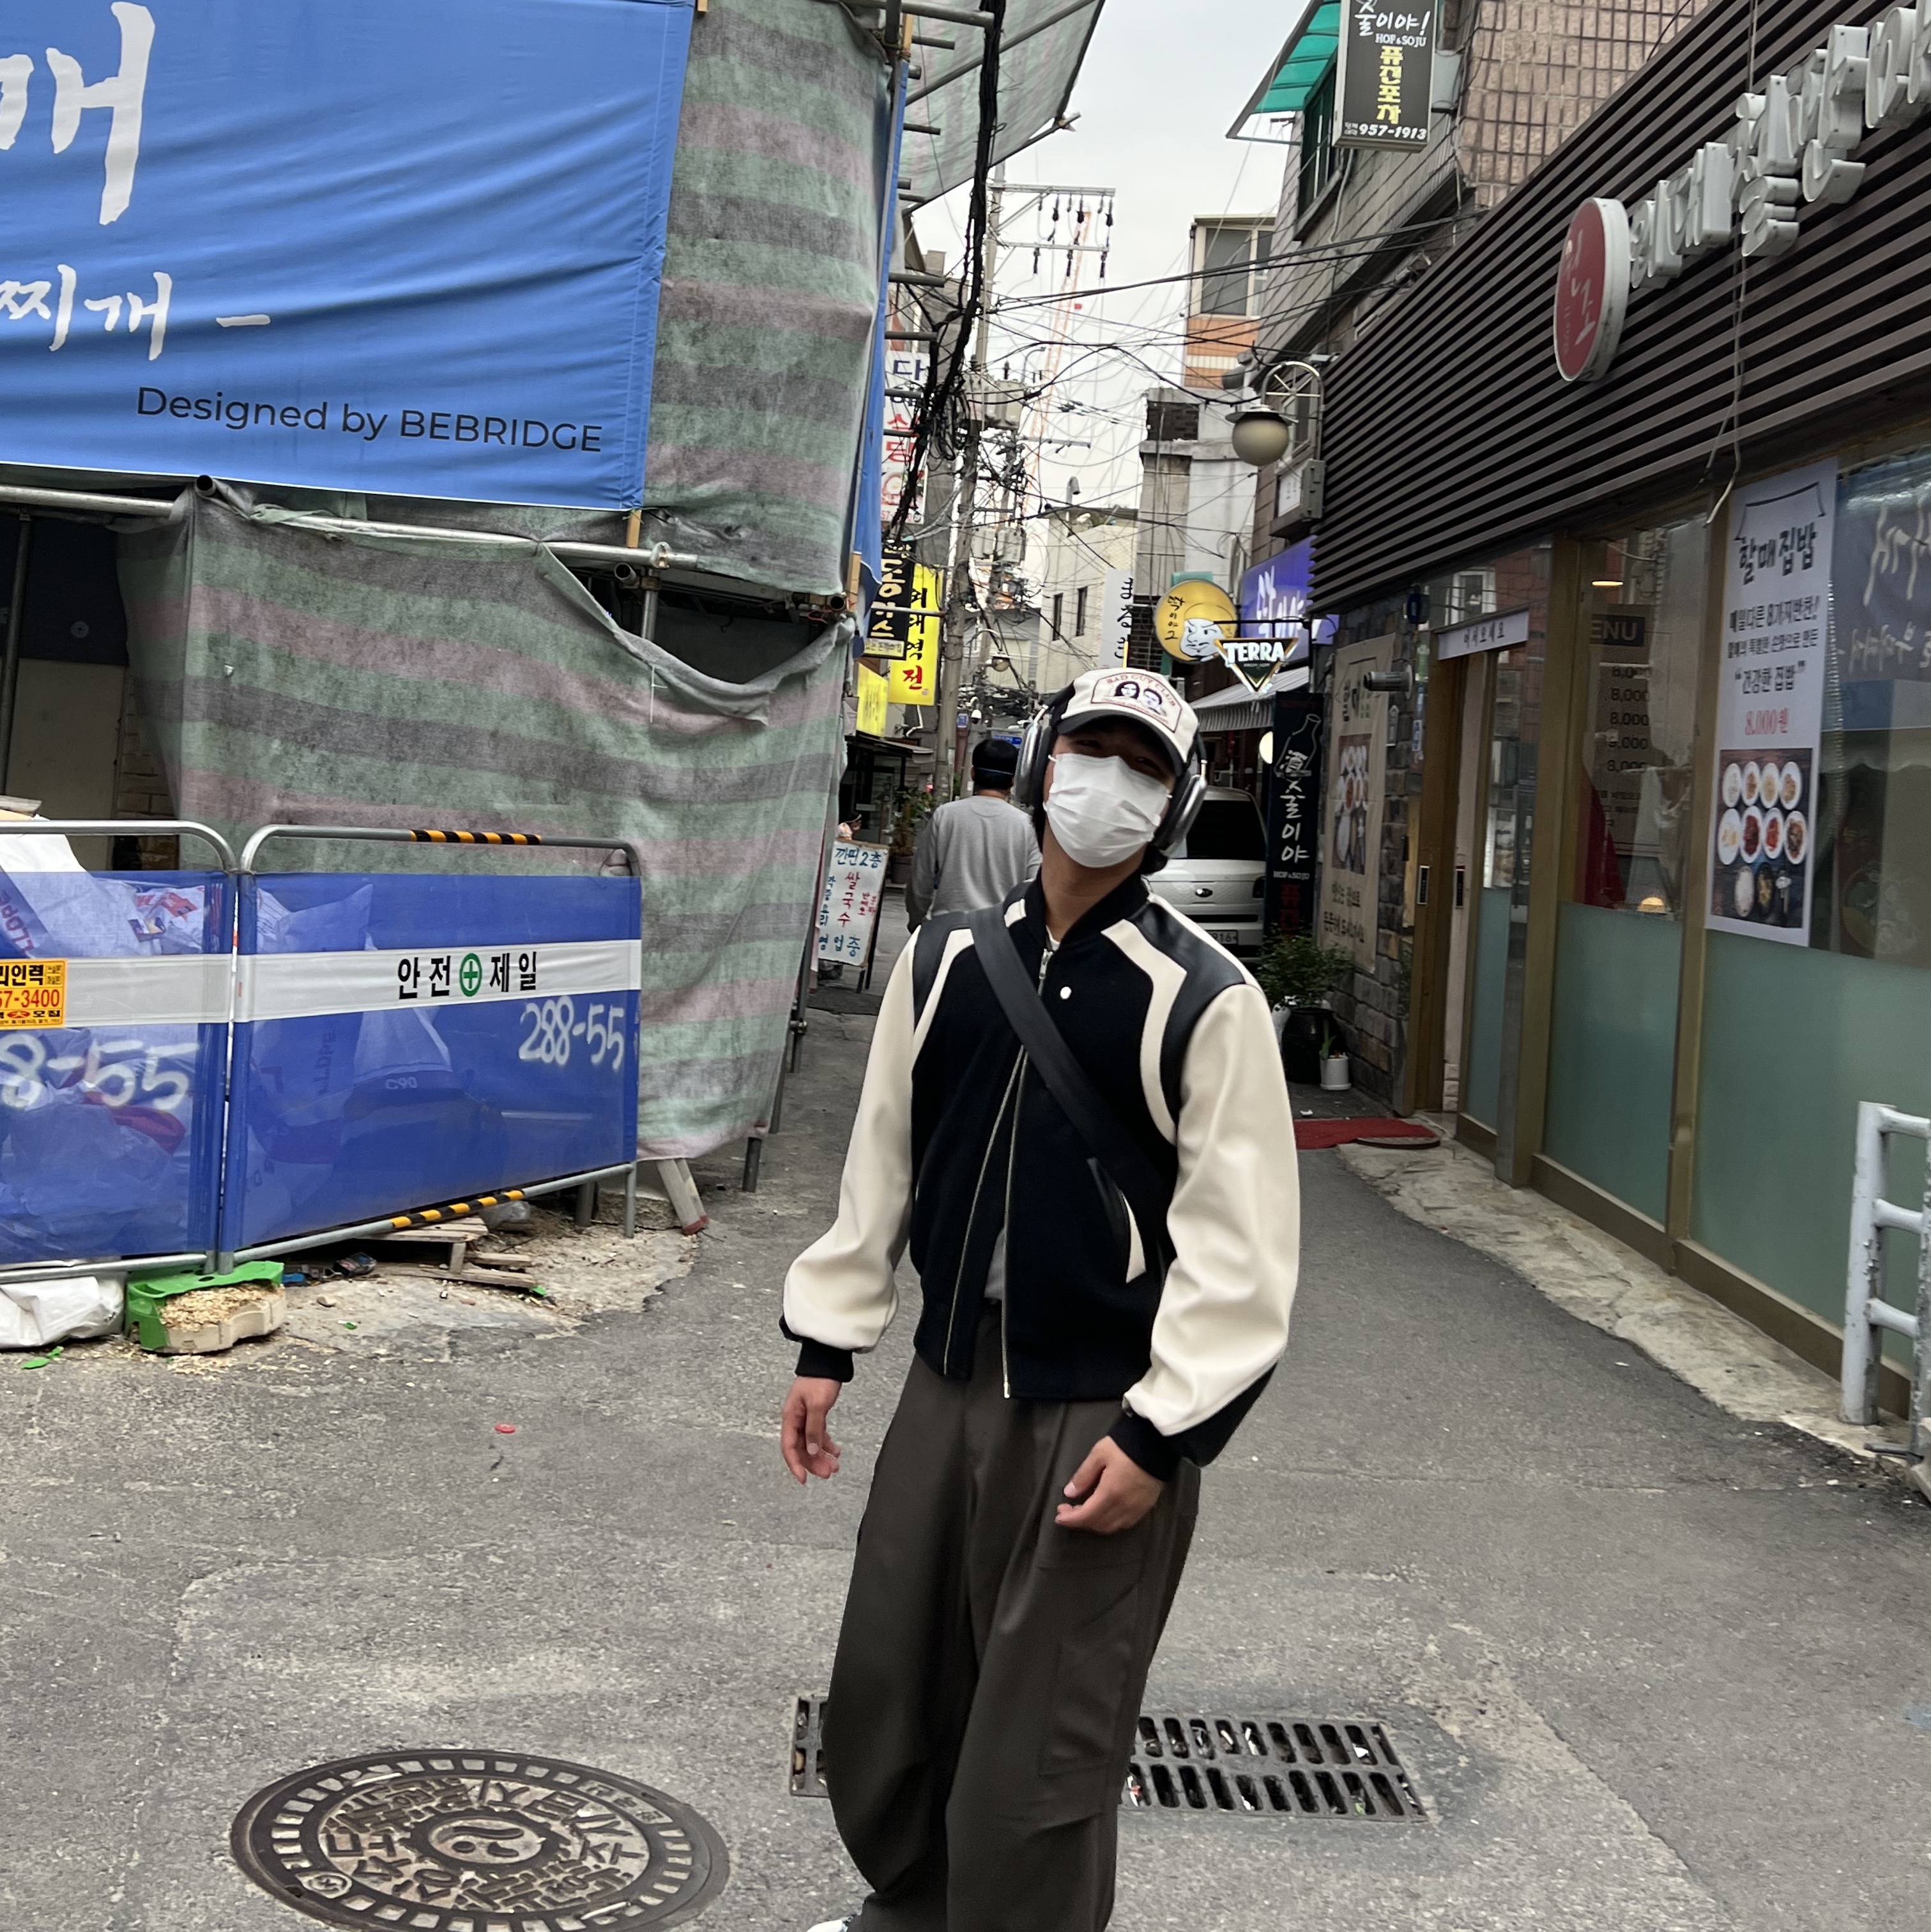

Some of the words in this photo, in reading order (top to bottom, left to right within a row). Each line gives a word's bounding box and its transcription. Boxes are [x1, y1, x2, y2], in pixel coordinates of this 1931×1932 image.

[1359, 124, 1426, 140] 957-1913
[136, 386, 328, 430] Designed
[342, 403, 388, 440] by
[399, 410, 602, 452] BEBRIDGE
[1738, 521, 1817, 585] 할매집밥
[1223, 641, 1285, 663] TERRA
[837, 871, 860, 928] 쌀국수
[397, 956, 452, 1000] 안전
[489, 951, 537, 993] 제일
